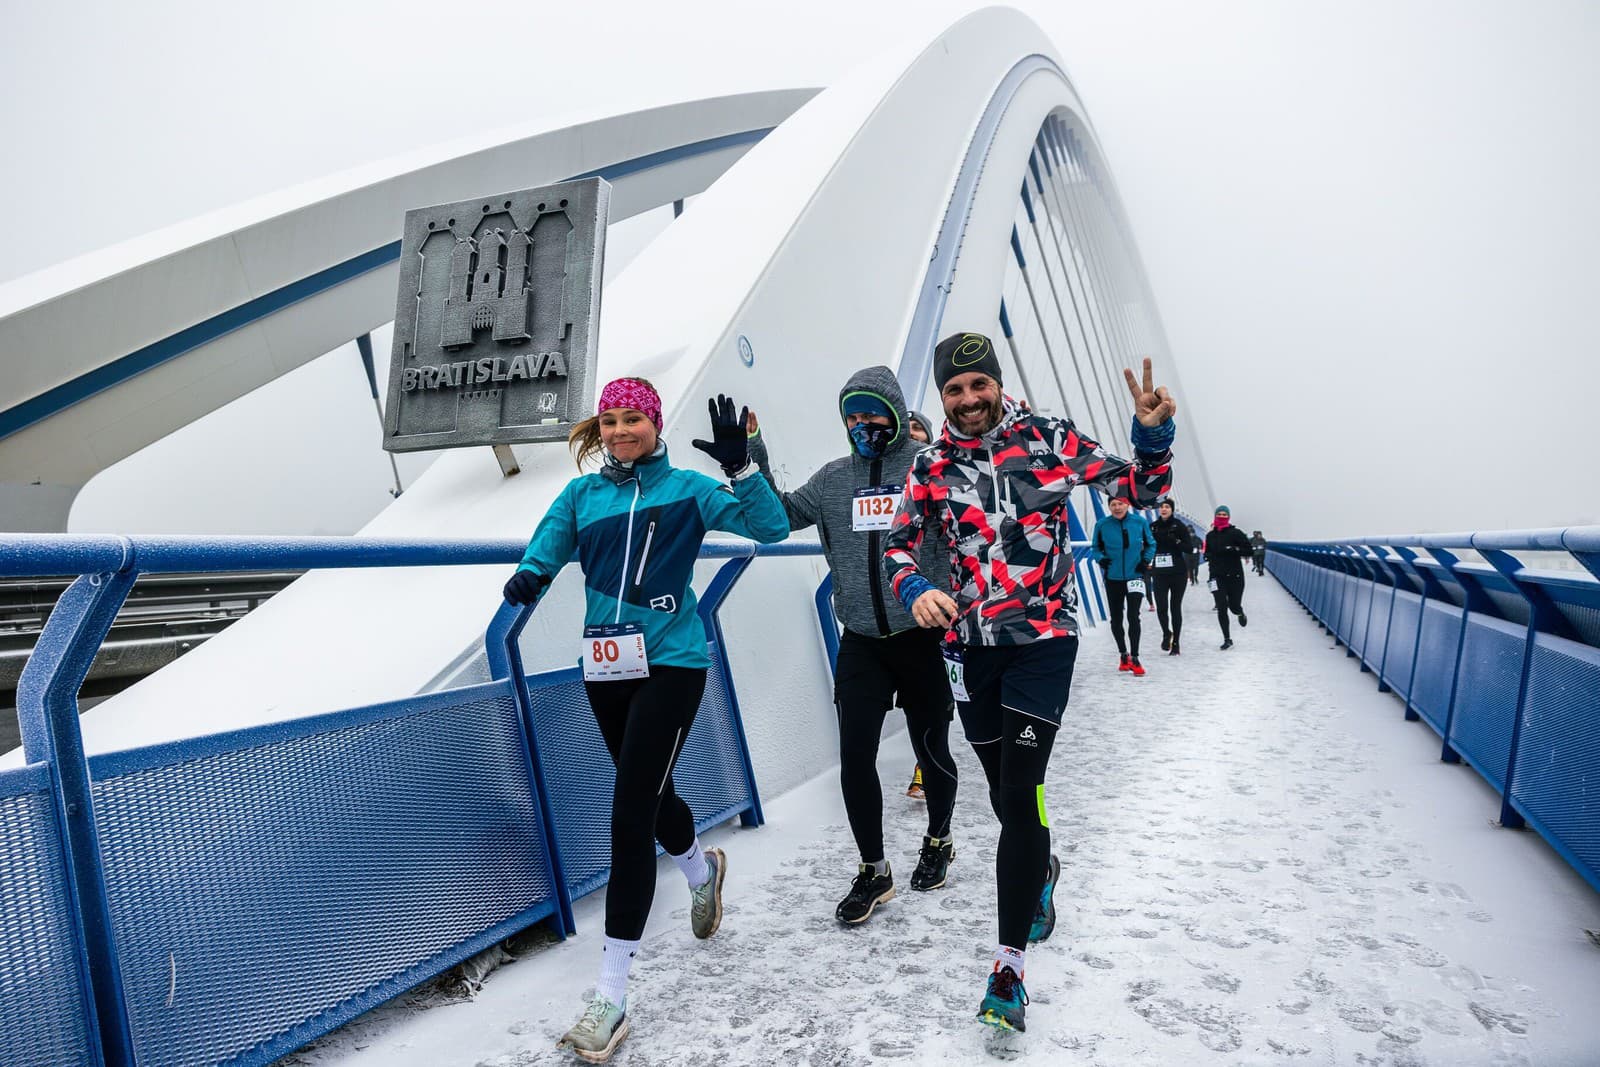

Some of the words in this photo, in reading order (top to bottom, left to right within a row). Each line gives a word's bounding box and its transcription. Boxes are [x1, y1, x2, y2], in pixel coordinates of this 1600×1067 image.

[402, 352, 567, 392] BRATISLAVA
[858, 497, 893, 516] 1132
[592, 640, 619, 662] 80
